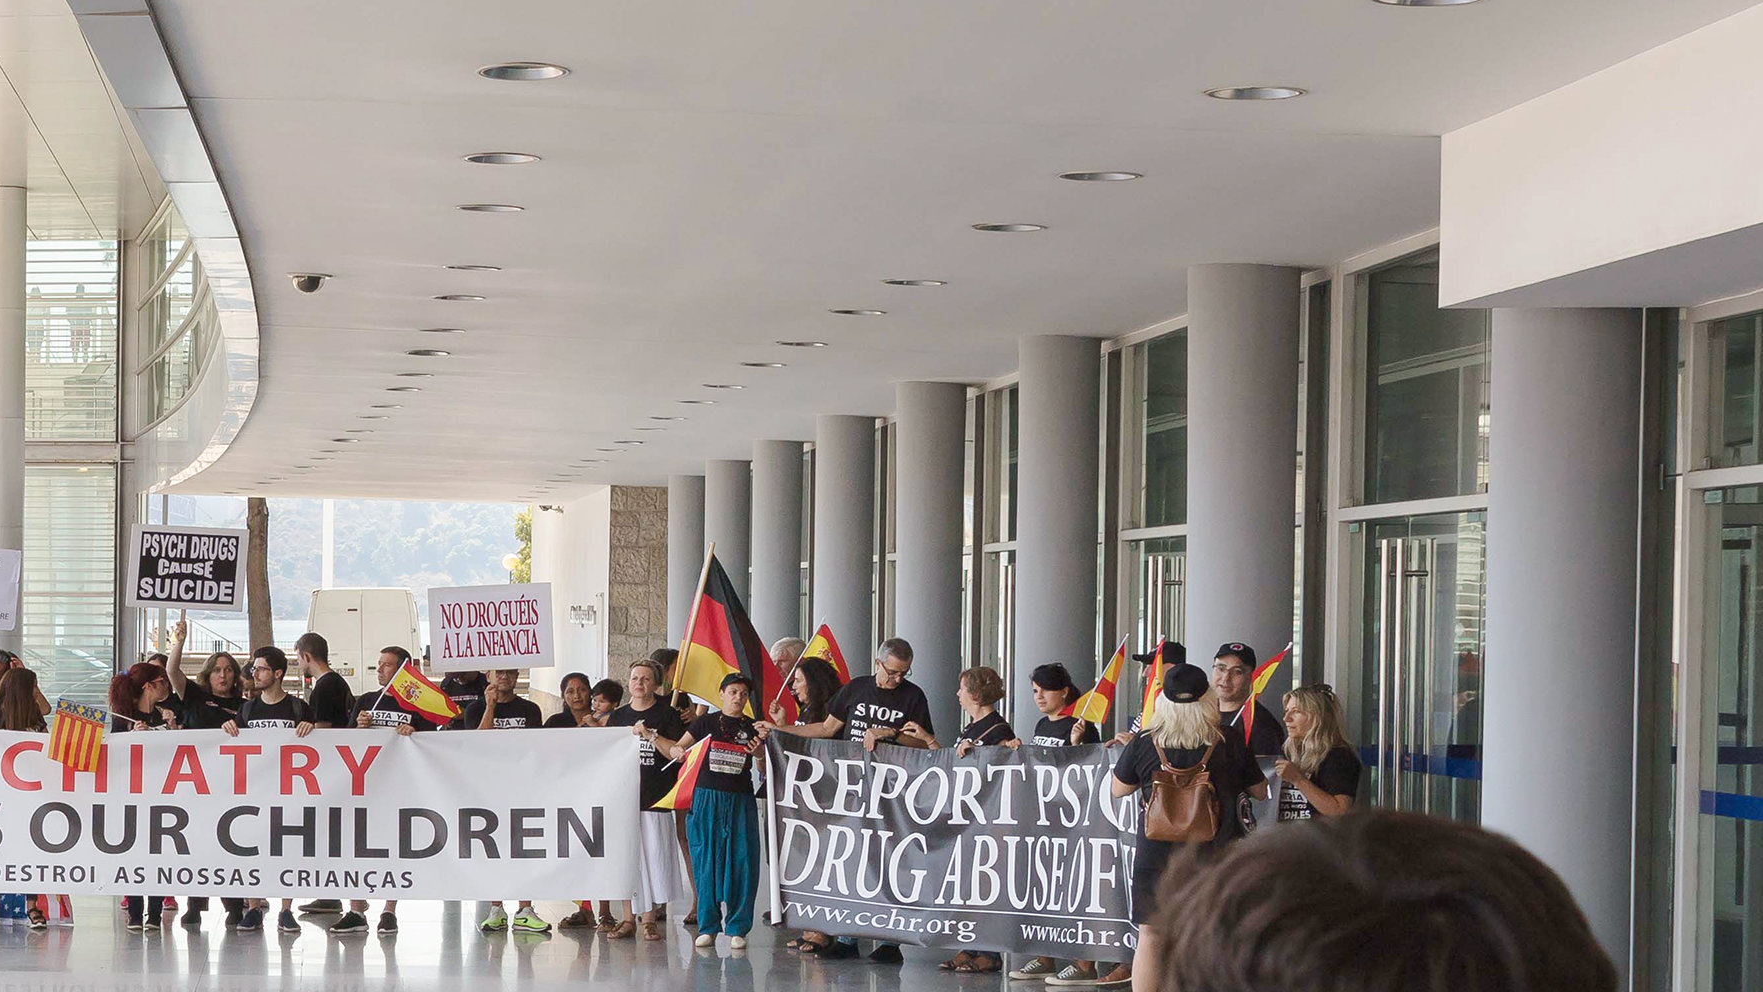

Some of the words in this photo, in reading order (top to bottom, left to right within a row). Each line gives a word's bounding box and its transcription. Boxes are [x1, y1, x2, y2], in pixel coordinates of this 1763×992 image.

[142, 533, 187, 558] PSYCH
[191, 536, 237, 562] DRUGS
[158, 558, 214, 579] CAUSE
[139, 577, 234, 602] SUICIDE
[440, 602, 463, 629] NO
[466, 593, 539, 628] DROGUÉIS
[443, 633, 454, 659] A
[455, 631, 475, 658] LA
[477, 628, 540, 657] INFANCIA
[282, 720, 293, 728] YA
[396, 713, 408, 721] YA
[854, 703, 904, 722] STOP
[776, 750, 1026, 826] REPORT
[29, 803, 191, 856] OUR
[216, 805, 605, 859] CHILDREN
[114, 866, 146, 884] AS
[156, 866, 262, 887] NOSSAS
[279, 869, 414, 893] CRIANÇAS
[779, 818, 928, 905] DRUG
[934, 834, 1067, 912] ABUSE
[1067, 836, 1118, 914] OF
